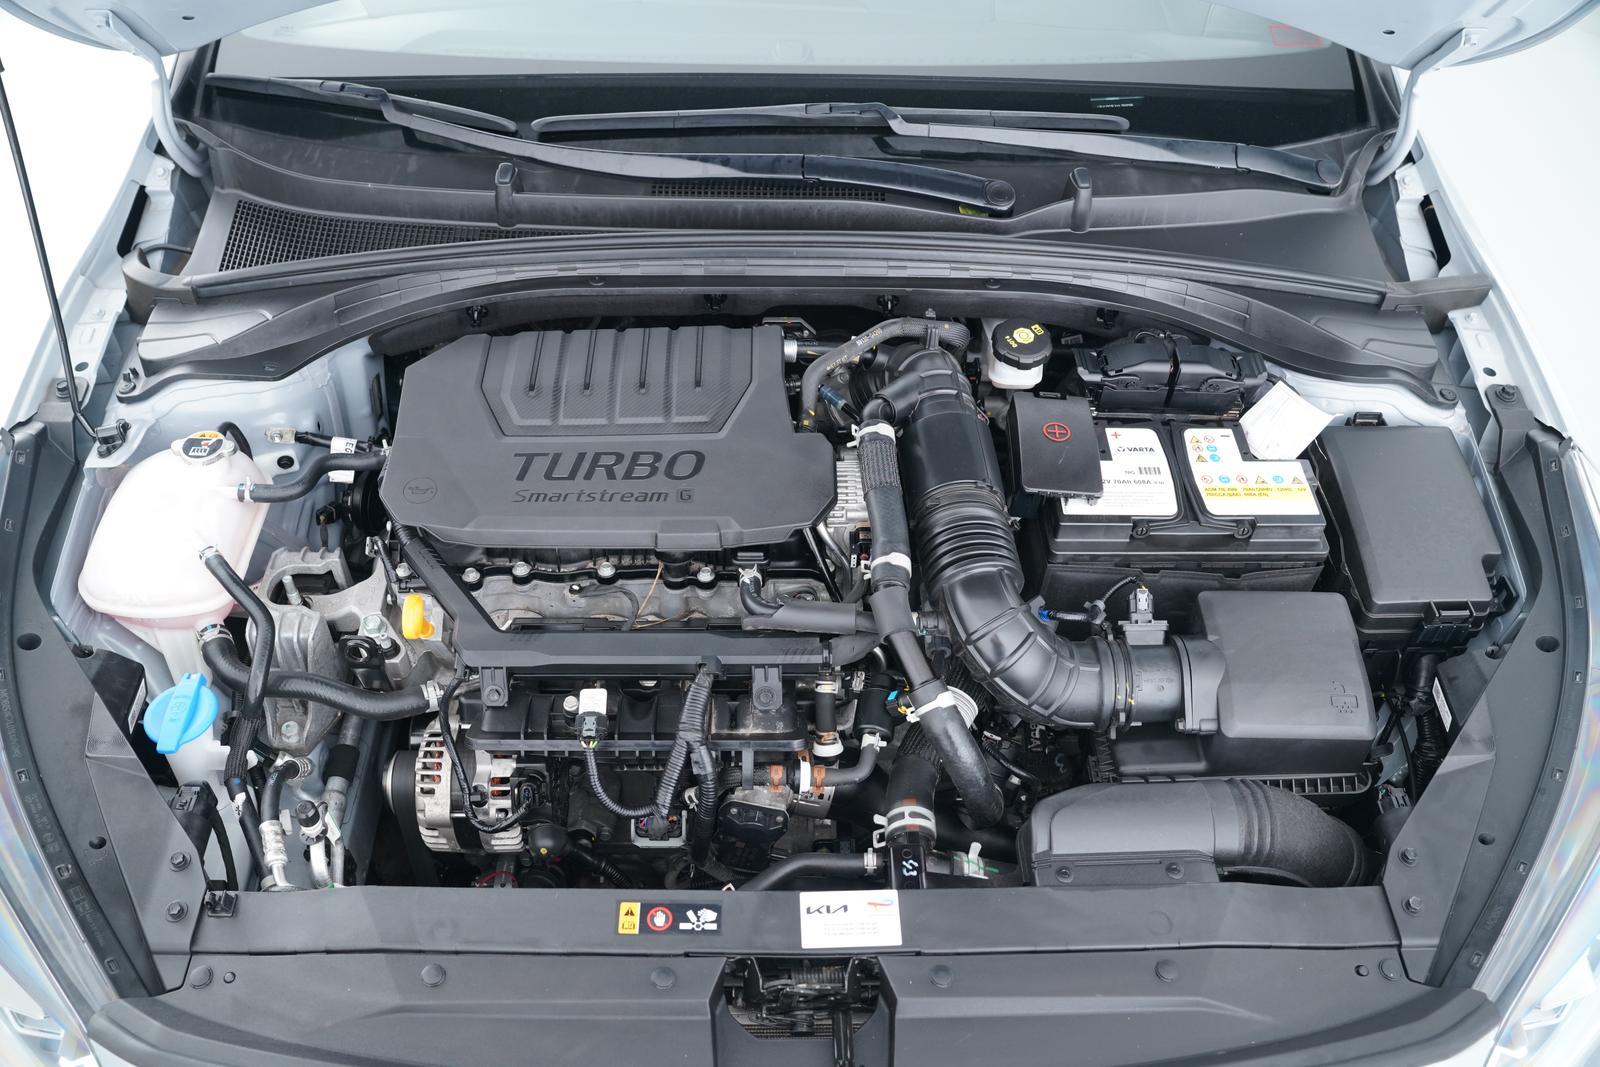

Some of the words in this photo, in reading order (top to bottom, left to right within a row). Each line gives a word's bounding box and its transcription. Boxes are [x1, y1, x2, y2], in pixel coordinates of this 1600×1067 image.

[513, 450, 706, 481] TURBO
[512, 488, 669, 503] Smartstream
[806, 904, 849, 915] KIA
